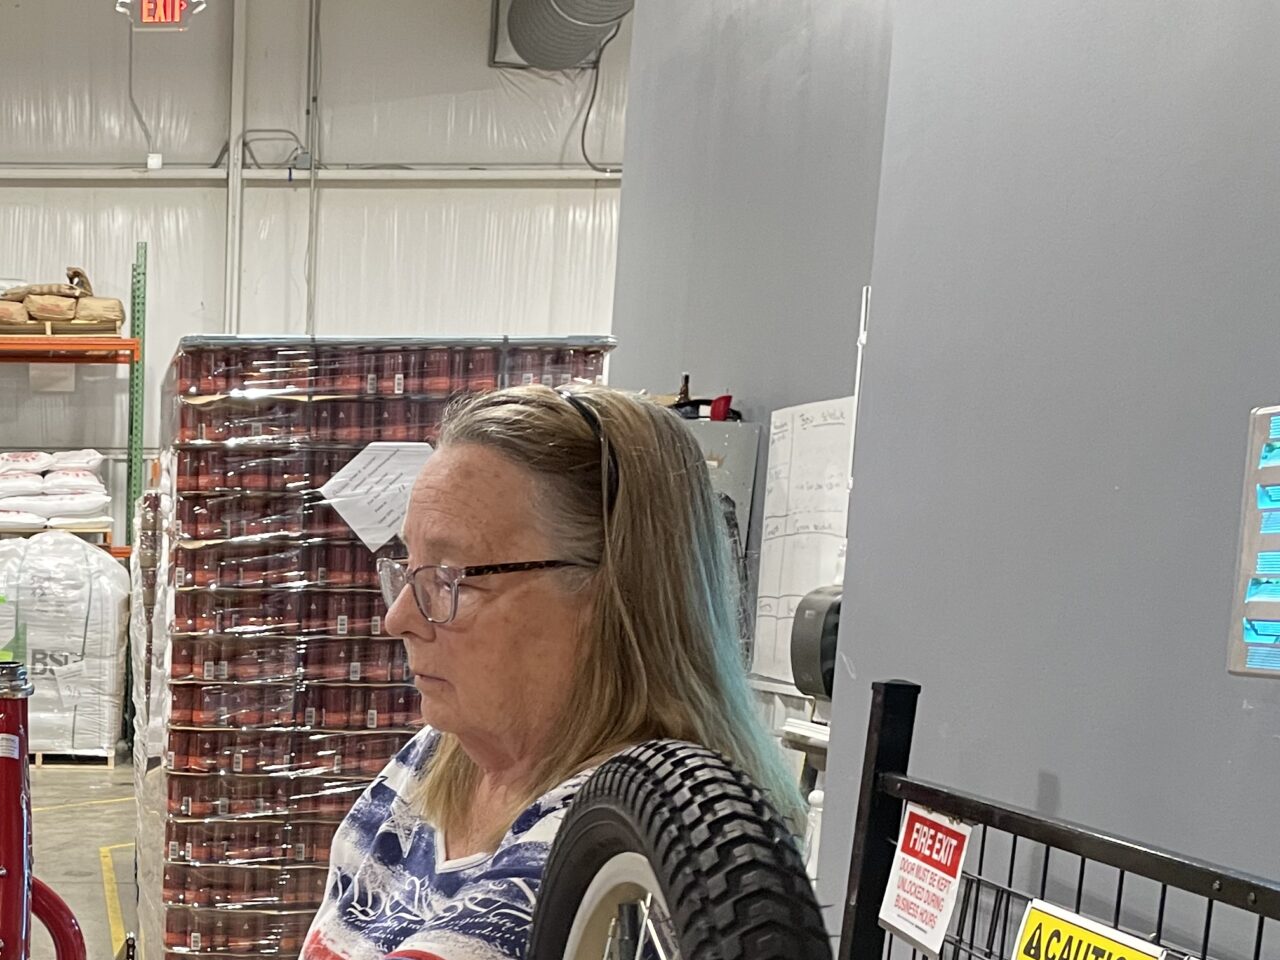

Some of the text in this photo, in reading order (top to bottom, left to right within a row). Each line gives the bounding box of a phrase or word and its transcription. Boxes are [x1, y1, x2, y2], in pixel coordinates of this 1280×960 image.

[141, 0, 181, 22] EXIT
[31, 648, 74, 676] BS
[909, 822, 958, 867] FIRE EXIT
[899, 857, 915, 876] DOOR
[915, 864, 931, 883] MUST
[928, 871, 938, 888] BE
[896, 876, 945, 913] UNLOCKED DURING
[893, 894, 920, 919] BUSINESS
[918, 907, 939, 930] HOURS
